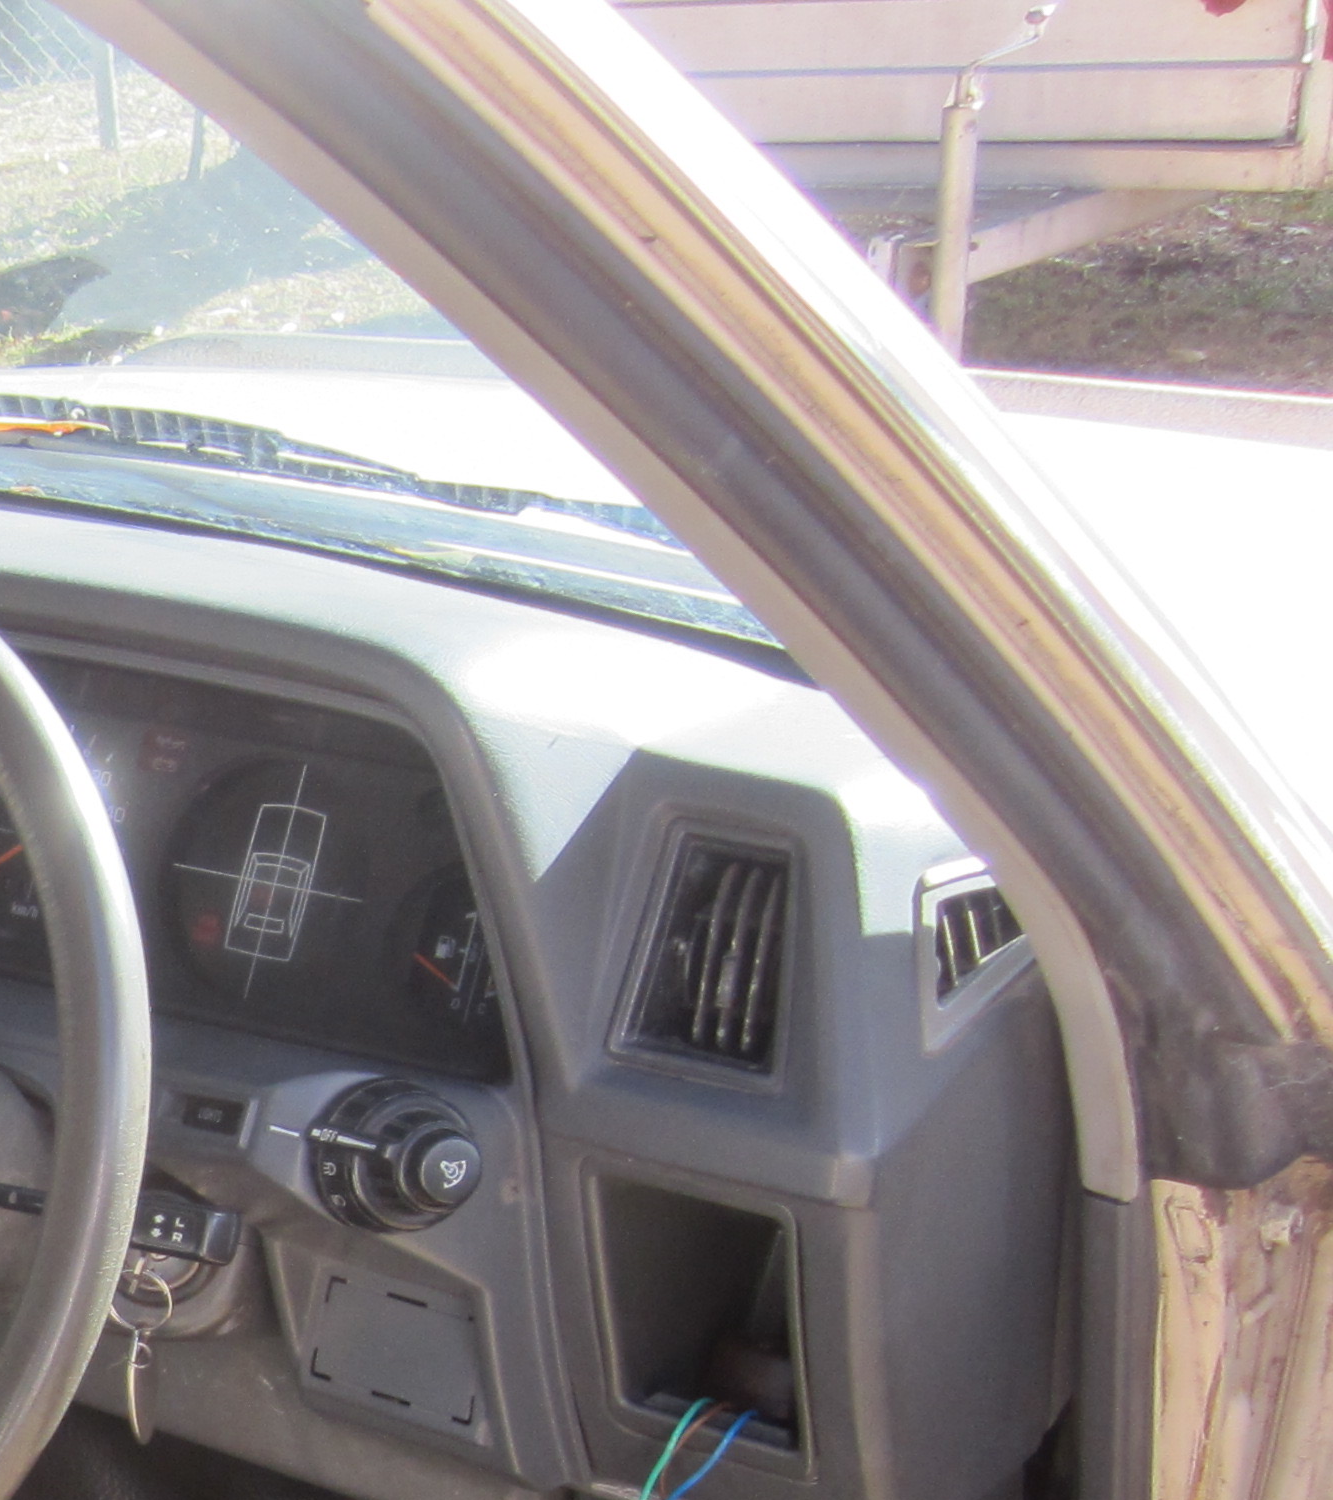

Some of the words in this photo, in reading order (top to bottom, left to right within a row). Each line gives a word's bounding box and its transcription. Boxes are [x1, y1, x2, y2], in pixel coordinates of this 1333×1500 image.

[319, 1127, 338, 1143] OFF
[174, 1216, 185, 1228] L
[172, 1231, 183, 1243] R
